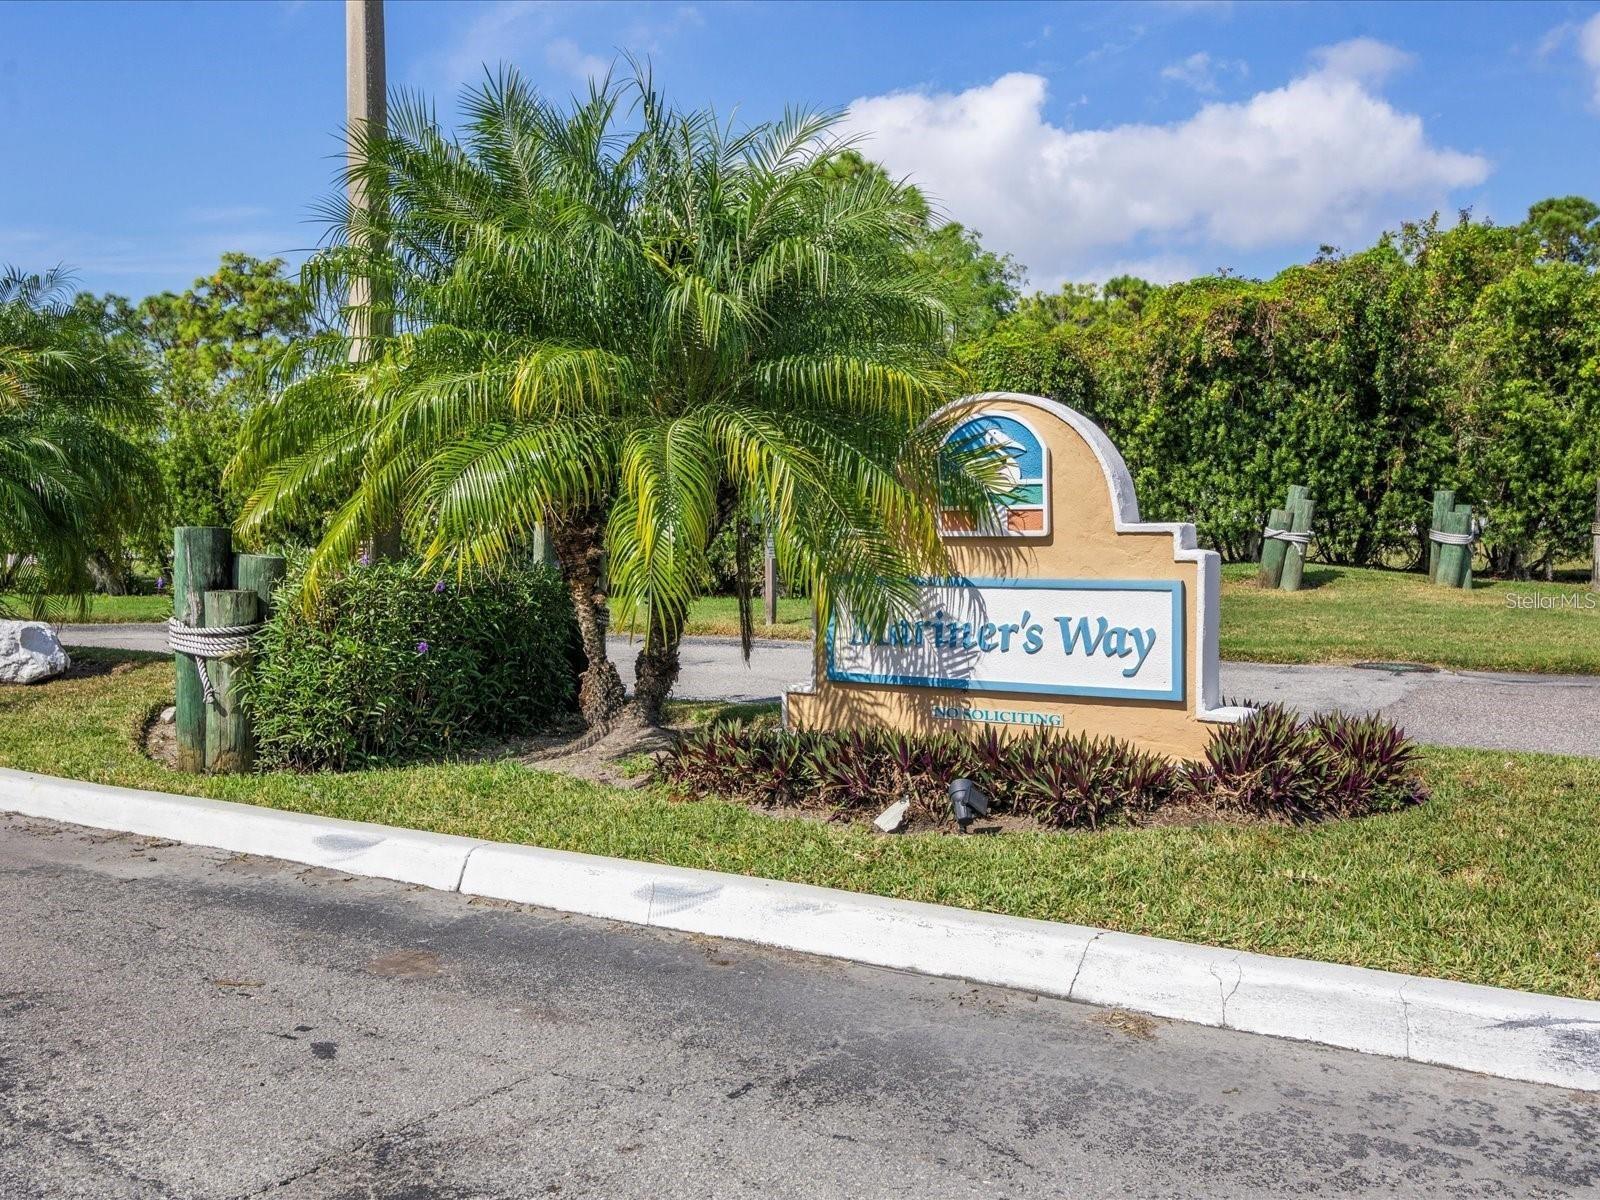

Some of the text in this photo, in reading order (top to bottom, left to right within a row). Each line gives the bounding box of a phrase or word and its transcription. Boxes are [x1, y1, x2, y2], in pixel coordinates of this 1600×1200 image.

[1054, 616, 1157, 678] Way
[934, 706, 1061, 726] NO SOLICITING
